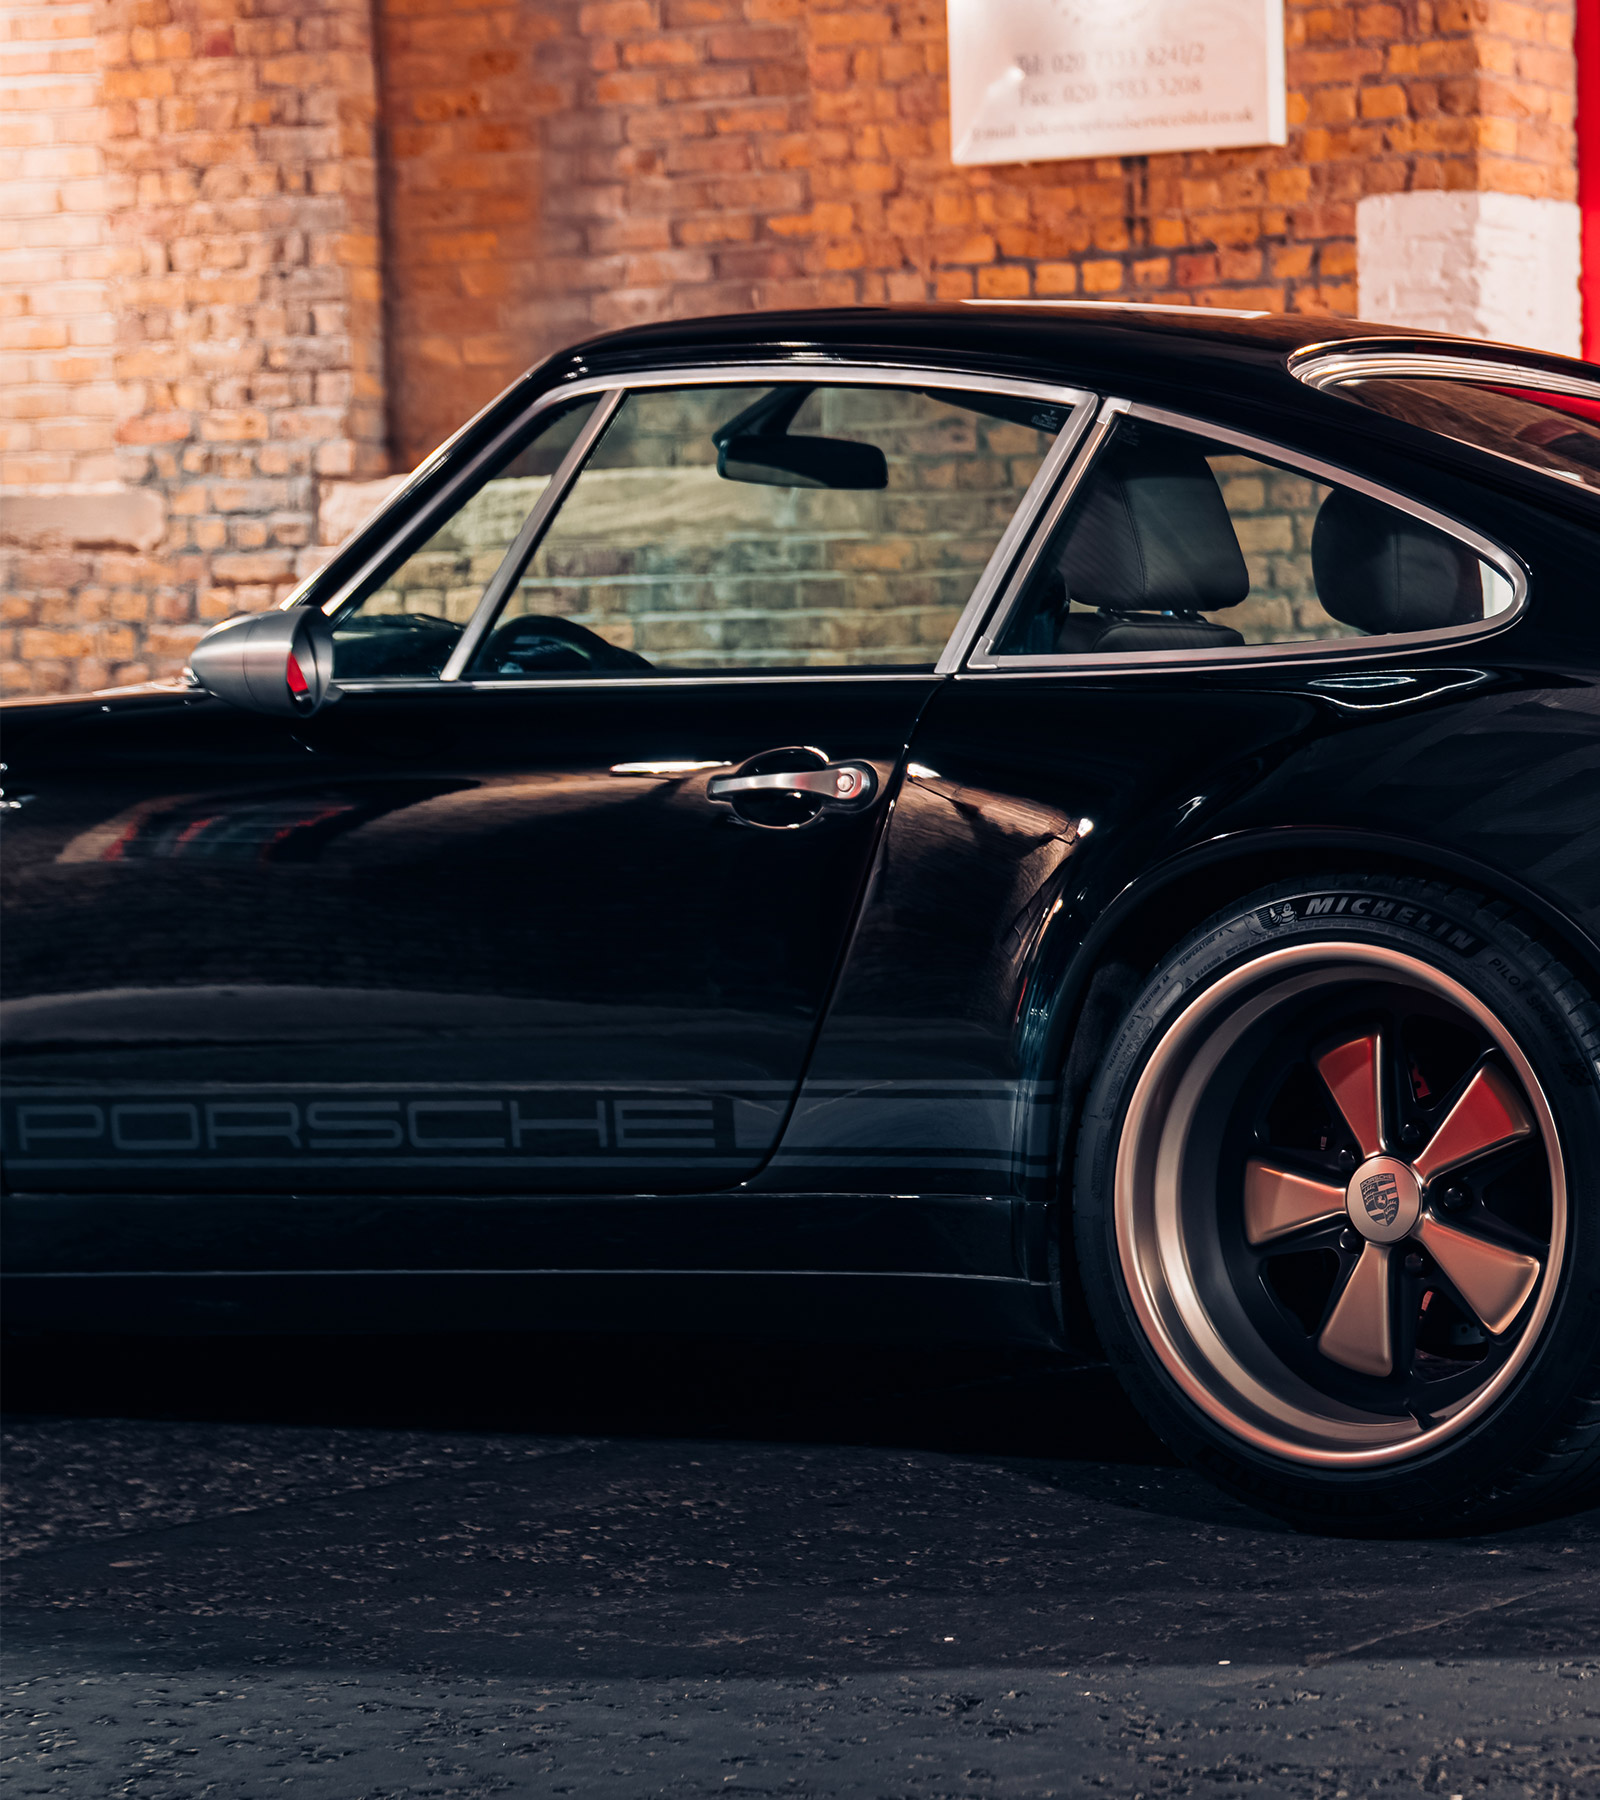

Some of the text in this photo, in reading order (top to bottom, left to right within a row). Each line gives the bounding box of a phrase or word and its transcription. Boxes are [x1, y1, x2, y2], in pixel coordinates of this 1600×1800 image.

[1304, 896, 1478, 951] MICHELIN
[1488, 957, 1530, 993] PILOT
[15, 1099, 716, 1152] PORSCHE
